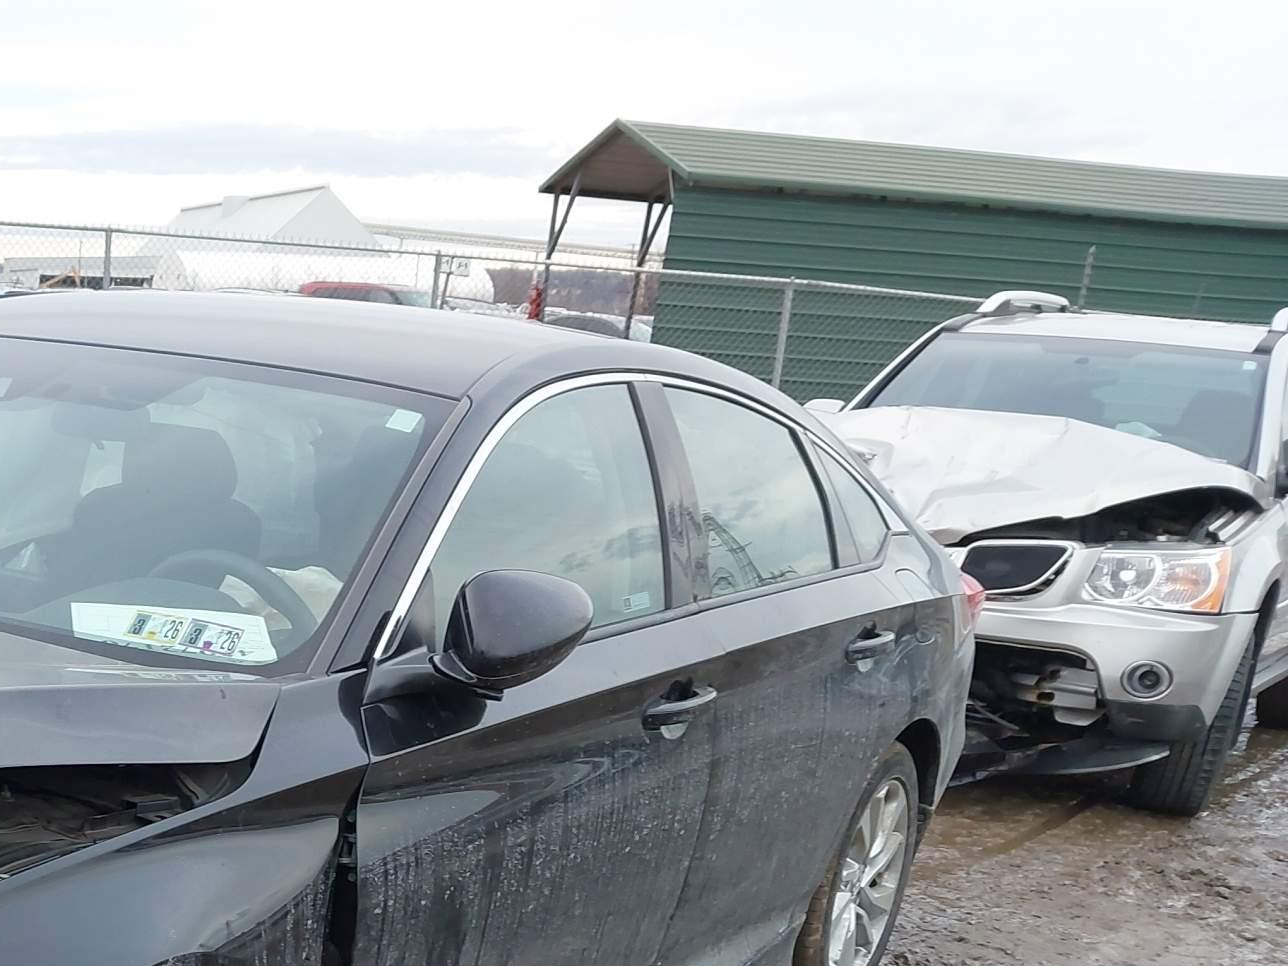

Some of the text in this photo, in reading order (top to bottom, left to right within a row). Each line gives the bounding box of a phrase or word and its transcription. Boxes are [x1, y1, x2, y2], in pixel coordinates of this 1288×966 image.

[132, 618, 184, 640] 3 26
[188, 627, 202, 645] 3
[219, 630, 240, 651] 26
